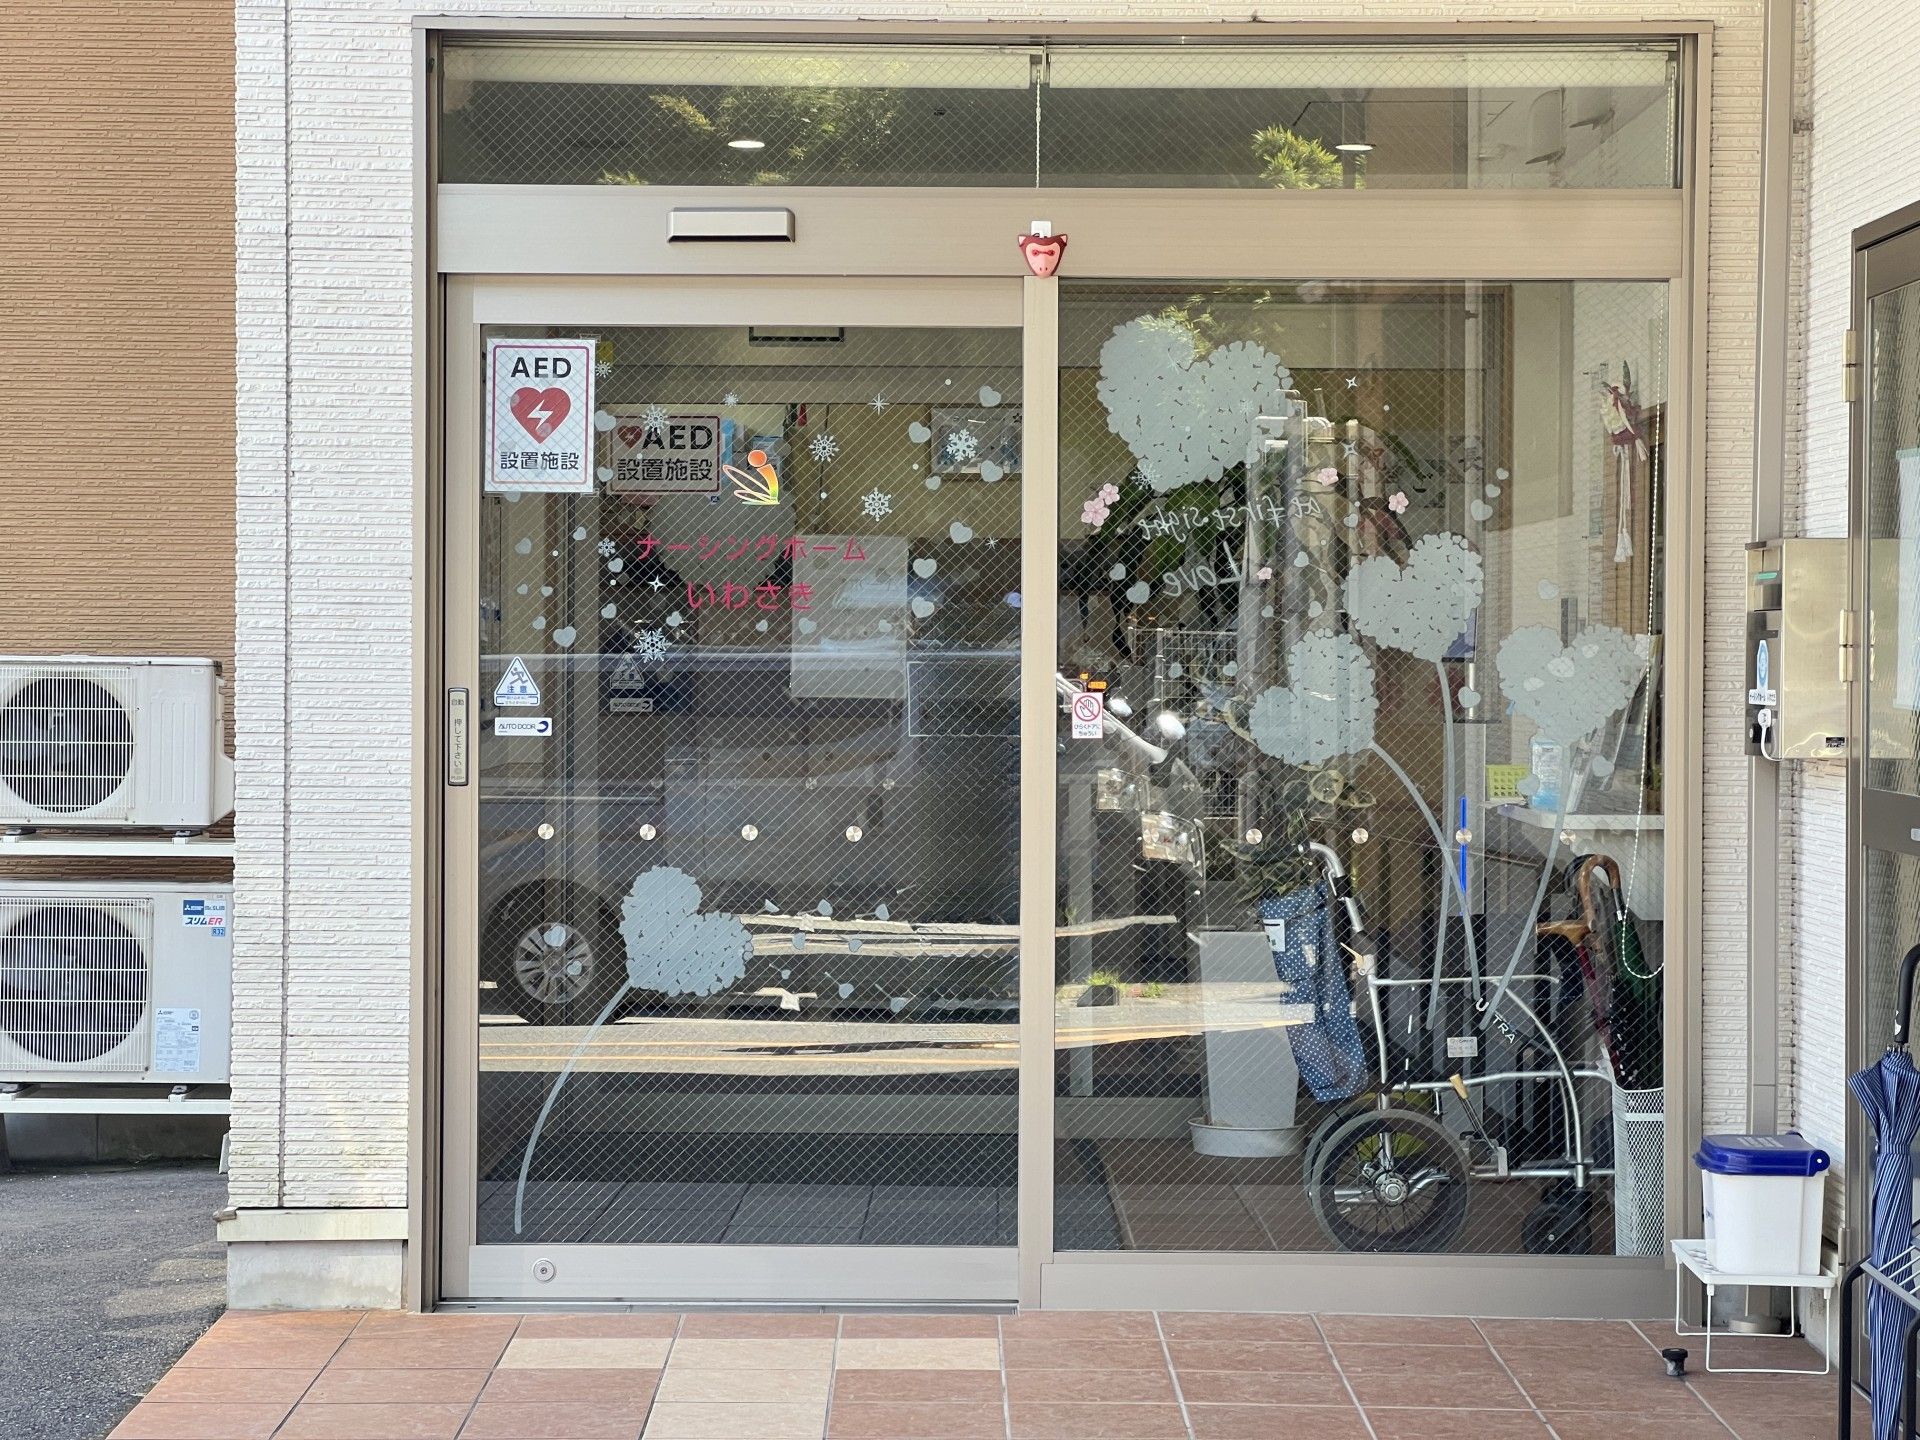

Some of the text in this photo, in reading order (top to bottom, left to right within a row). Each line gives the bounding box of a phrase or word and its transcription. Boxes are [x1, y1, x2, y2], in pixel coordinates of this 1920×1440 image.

[510, 356, 573, 379] AED
[642, 425, 713, 450] AED
[500, 451, 580, 472] 設置施設
[617, 458, 713, 481] 設置施設
[636, 535, 867, 561] ナーシングホーム
[685, 580, 817, 611] いわさき
[507, 685, 527, 693] 注意
